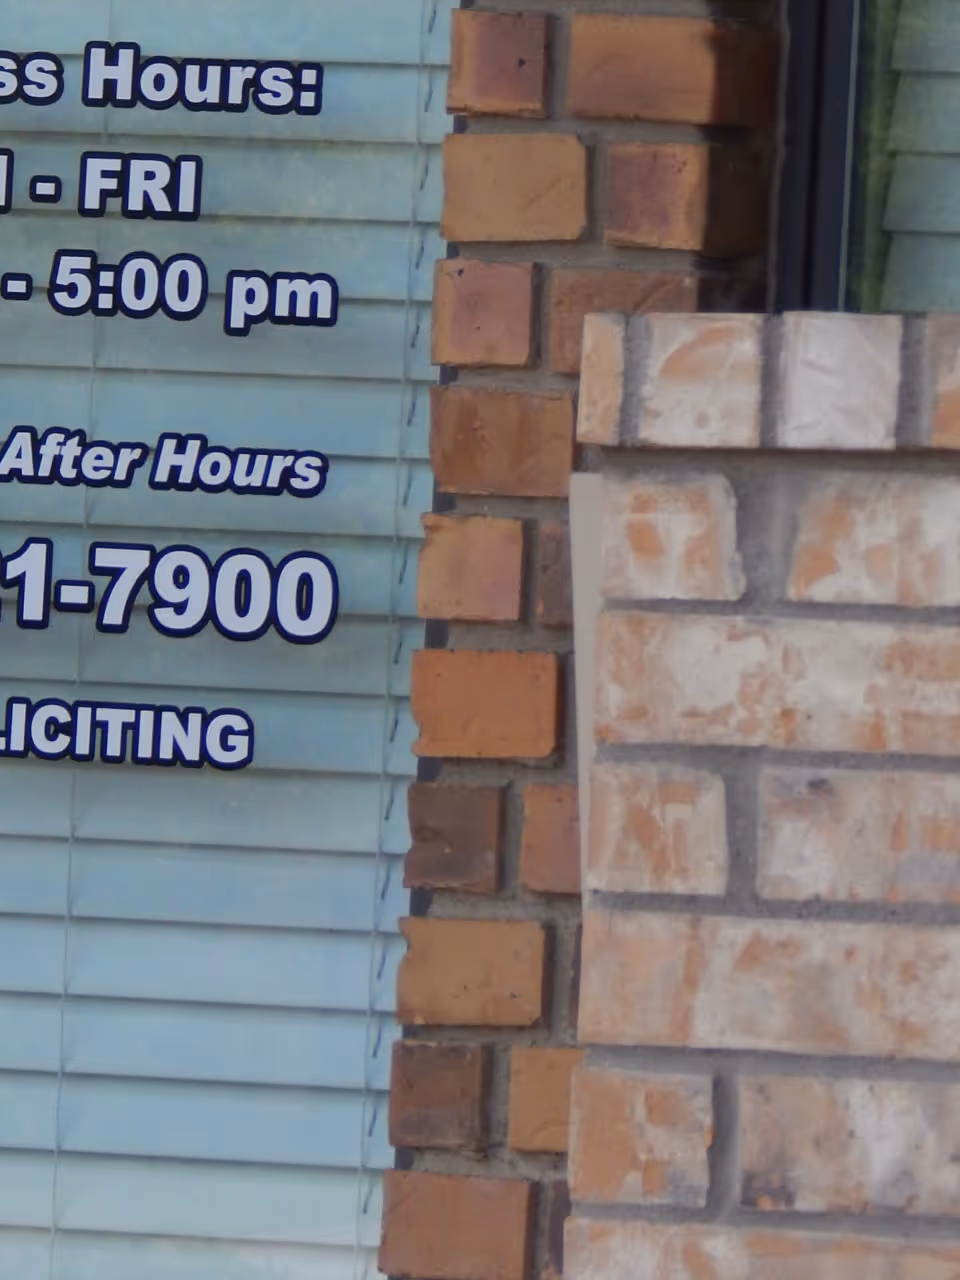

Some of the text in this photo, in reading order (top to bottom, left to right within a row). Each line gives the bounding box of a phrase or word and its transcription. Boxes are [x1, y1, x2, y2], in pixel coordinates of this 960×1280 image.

[83, 42, 323, 114] Hours:
[79, 153, 201, 218] FRI
[49, 250, 205, 320] 5:00
[225, 270, 337, 335] pm
[150, 434, 329, 496] Hours
